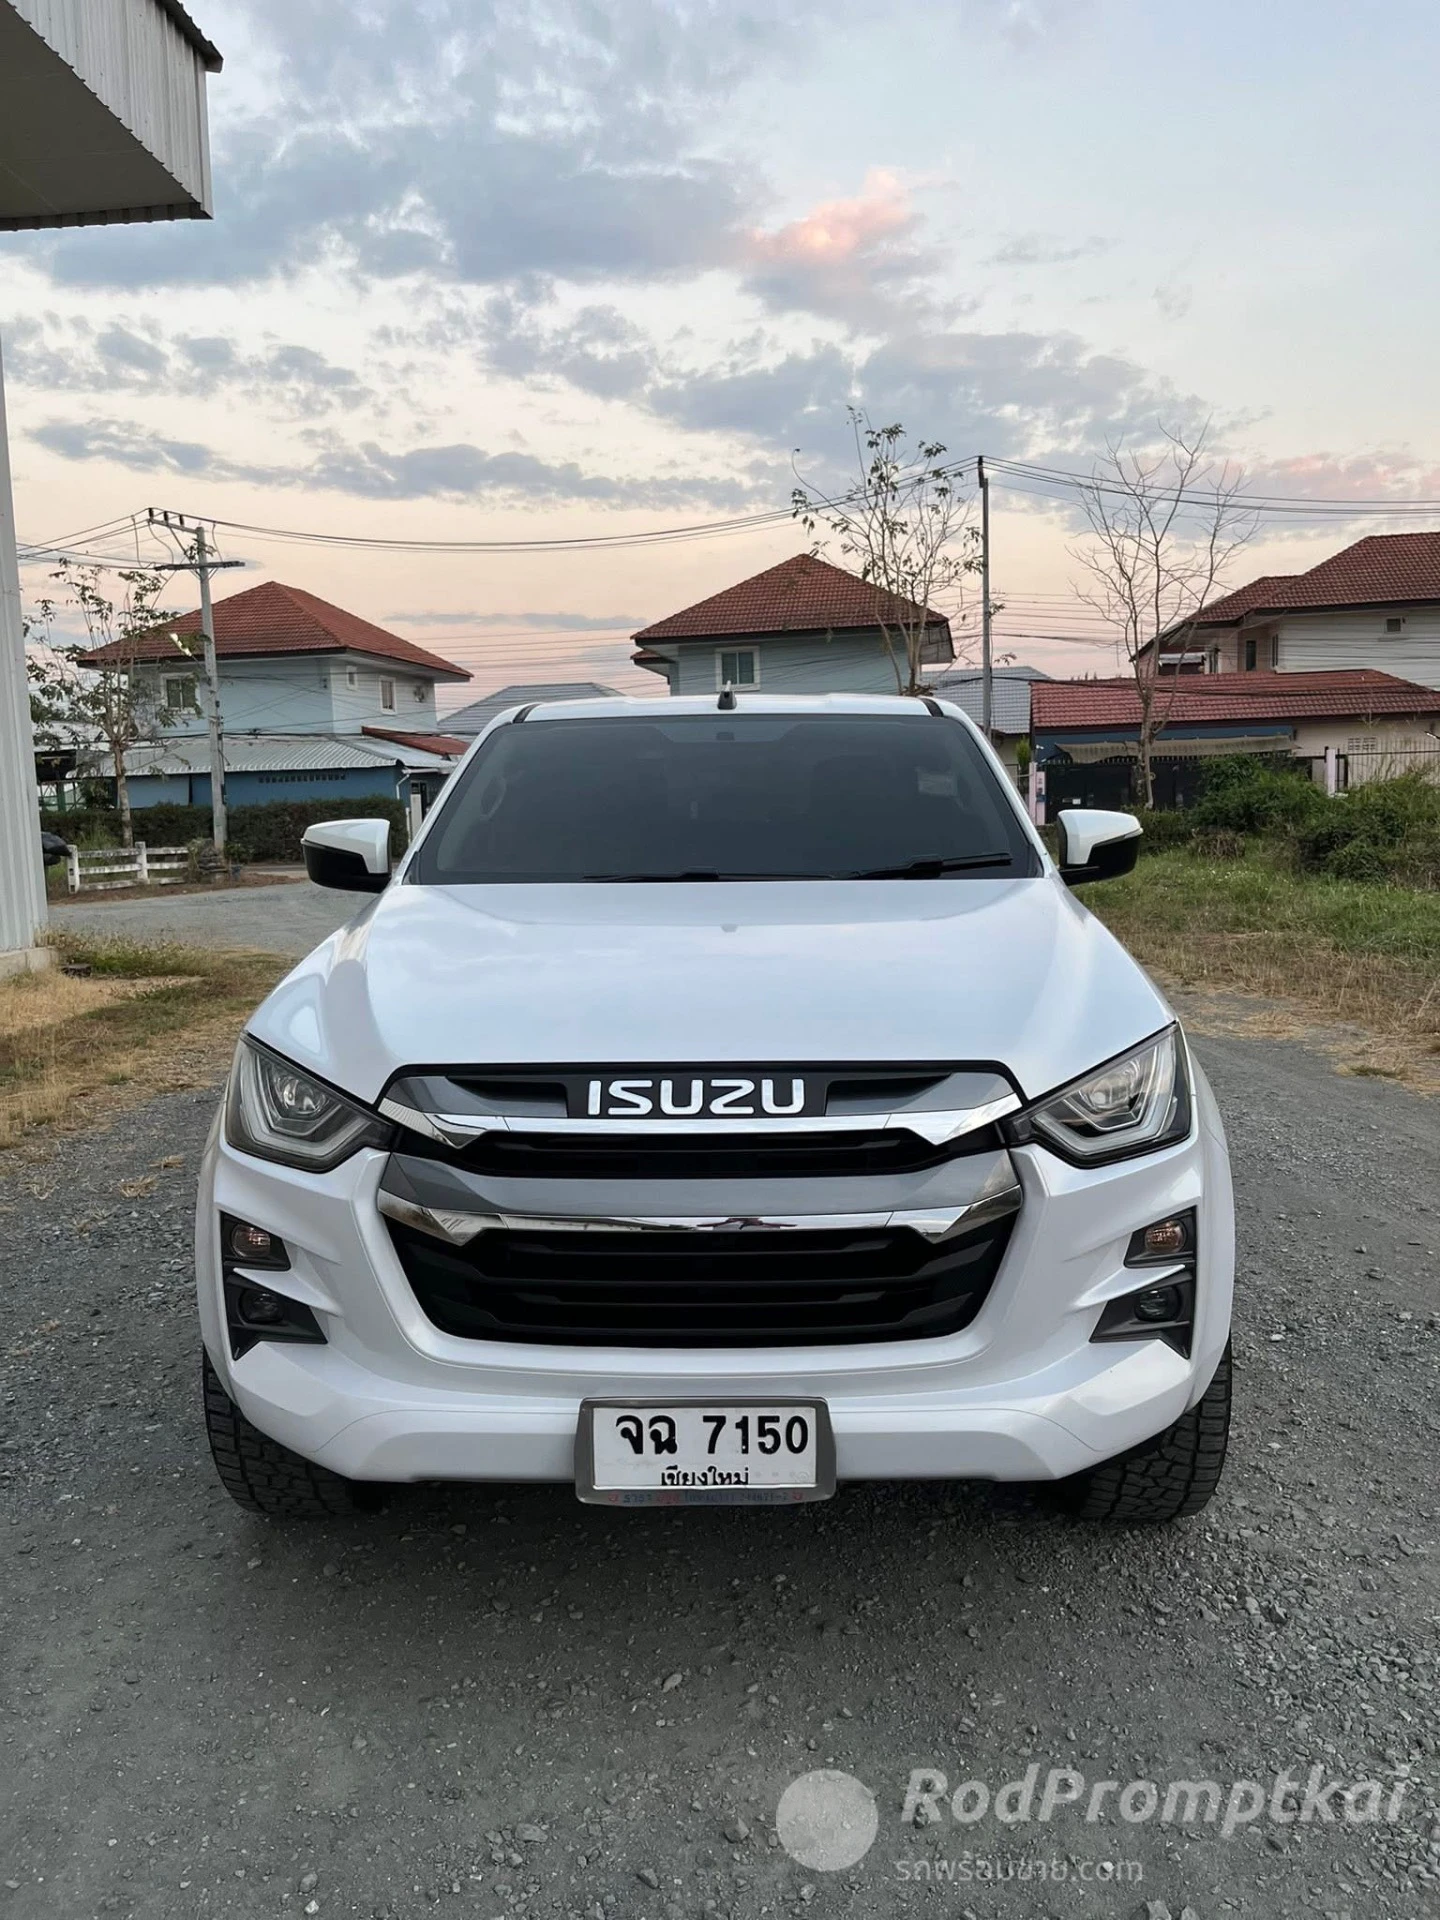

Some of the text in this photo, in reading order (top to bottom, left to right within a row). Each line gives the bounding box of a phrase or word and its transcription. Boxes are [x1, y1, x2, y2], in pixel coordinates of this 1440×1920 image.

[588, 1078, 805, 1115] ISUZU
[615, 1414, 809, 1455] จฉ 7150
[660, 1464, 750, 1486] เชียงใหม่
